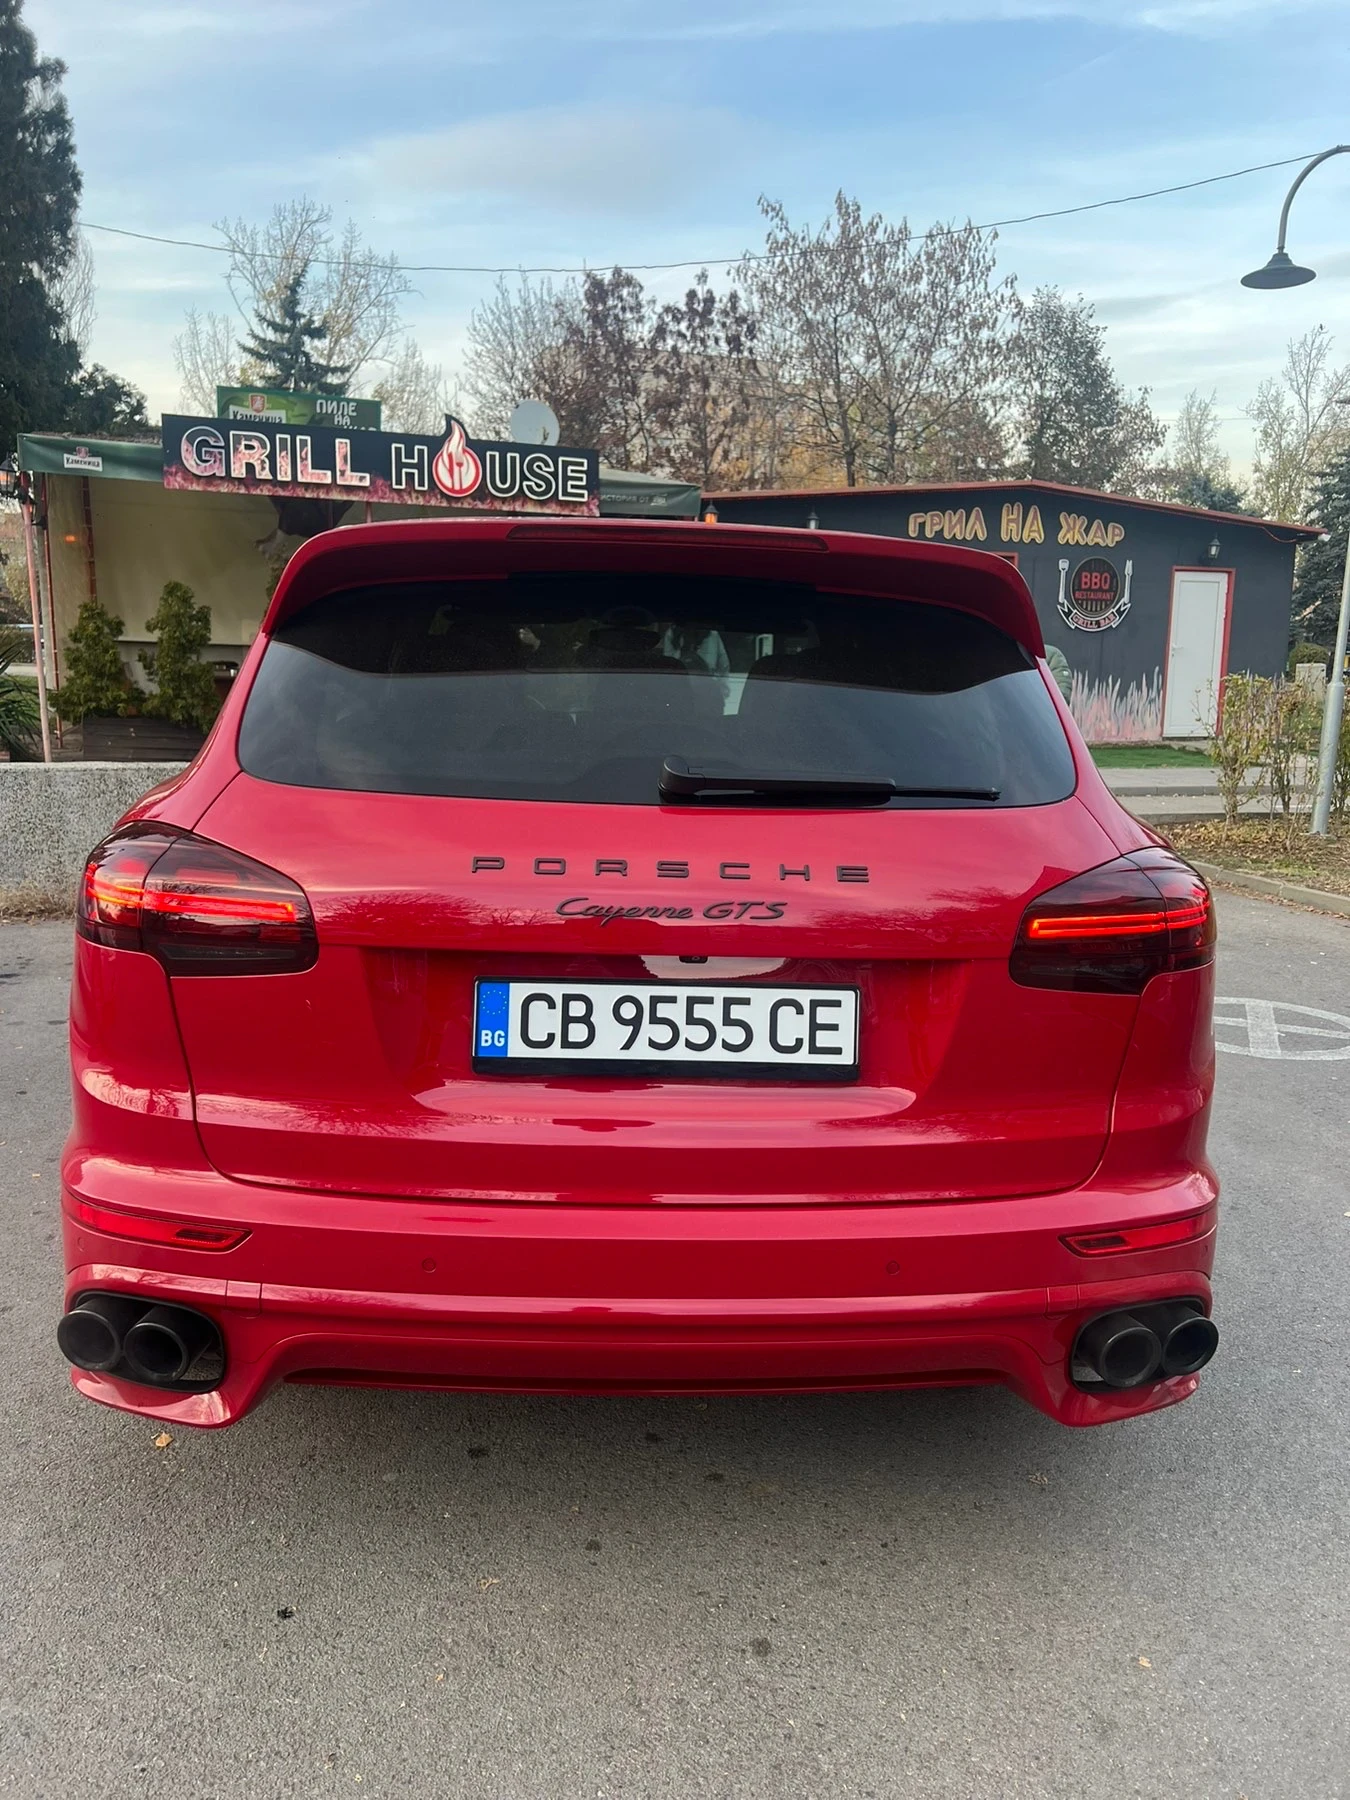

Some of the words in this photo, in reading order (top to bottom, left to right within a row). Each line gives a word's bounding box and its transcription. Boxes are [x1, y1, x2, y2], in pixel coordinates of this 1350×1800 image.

[316, 399, 357, 416] ПИЛЕ
[334, 415, 351, 426] НА
[180, 426, 370, 487] GRILL
[908, 507, 987, 541] ГРИЛ
[1000, 502, 1045, 544] НА
[1057, 512, 1125, 547] ЖАР
[1081, 572, 1111, 590] BBQ
[1075, 591, 1115, 600] RESTAURANT
[1072, 614, 1098, 628] GRILL
[1099, 613, 1116, 626] BAR
[471, 856, 870, 882] PORSCHE
[555, 897, 693, 927] Cayenne
[702, 901, 788, 920] GTS
[520, 992, 596, 1050] CB
[611, 995, 754, 1053] 9555
[769, 998, 843, 1055] CE
[480, 1029, 506, 1047] BG
